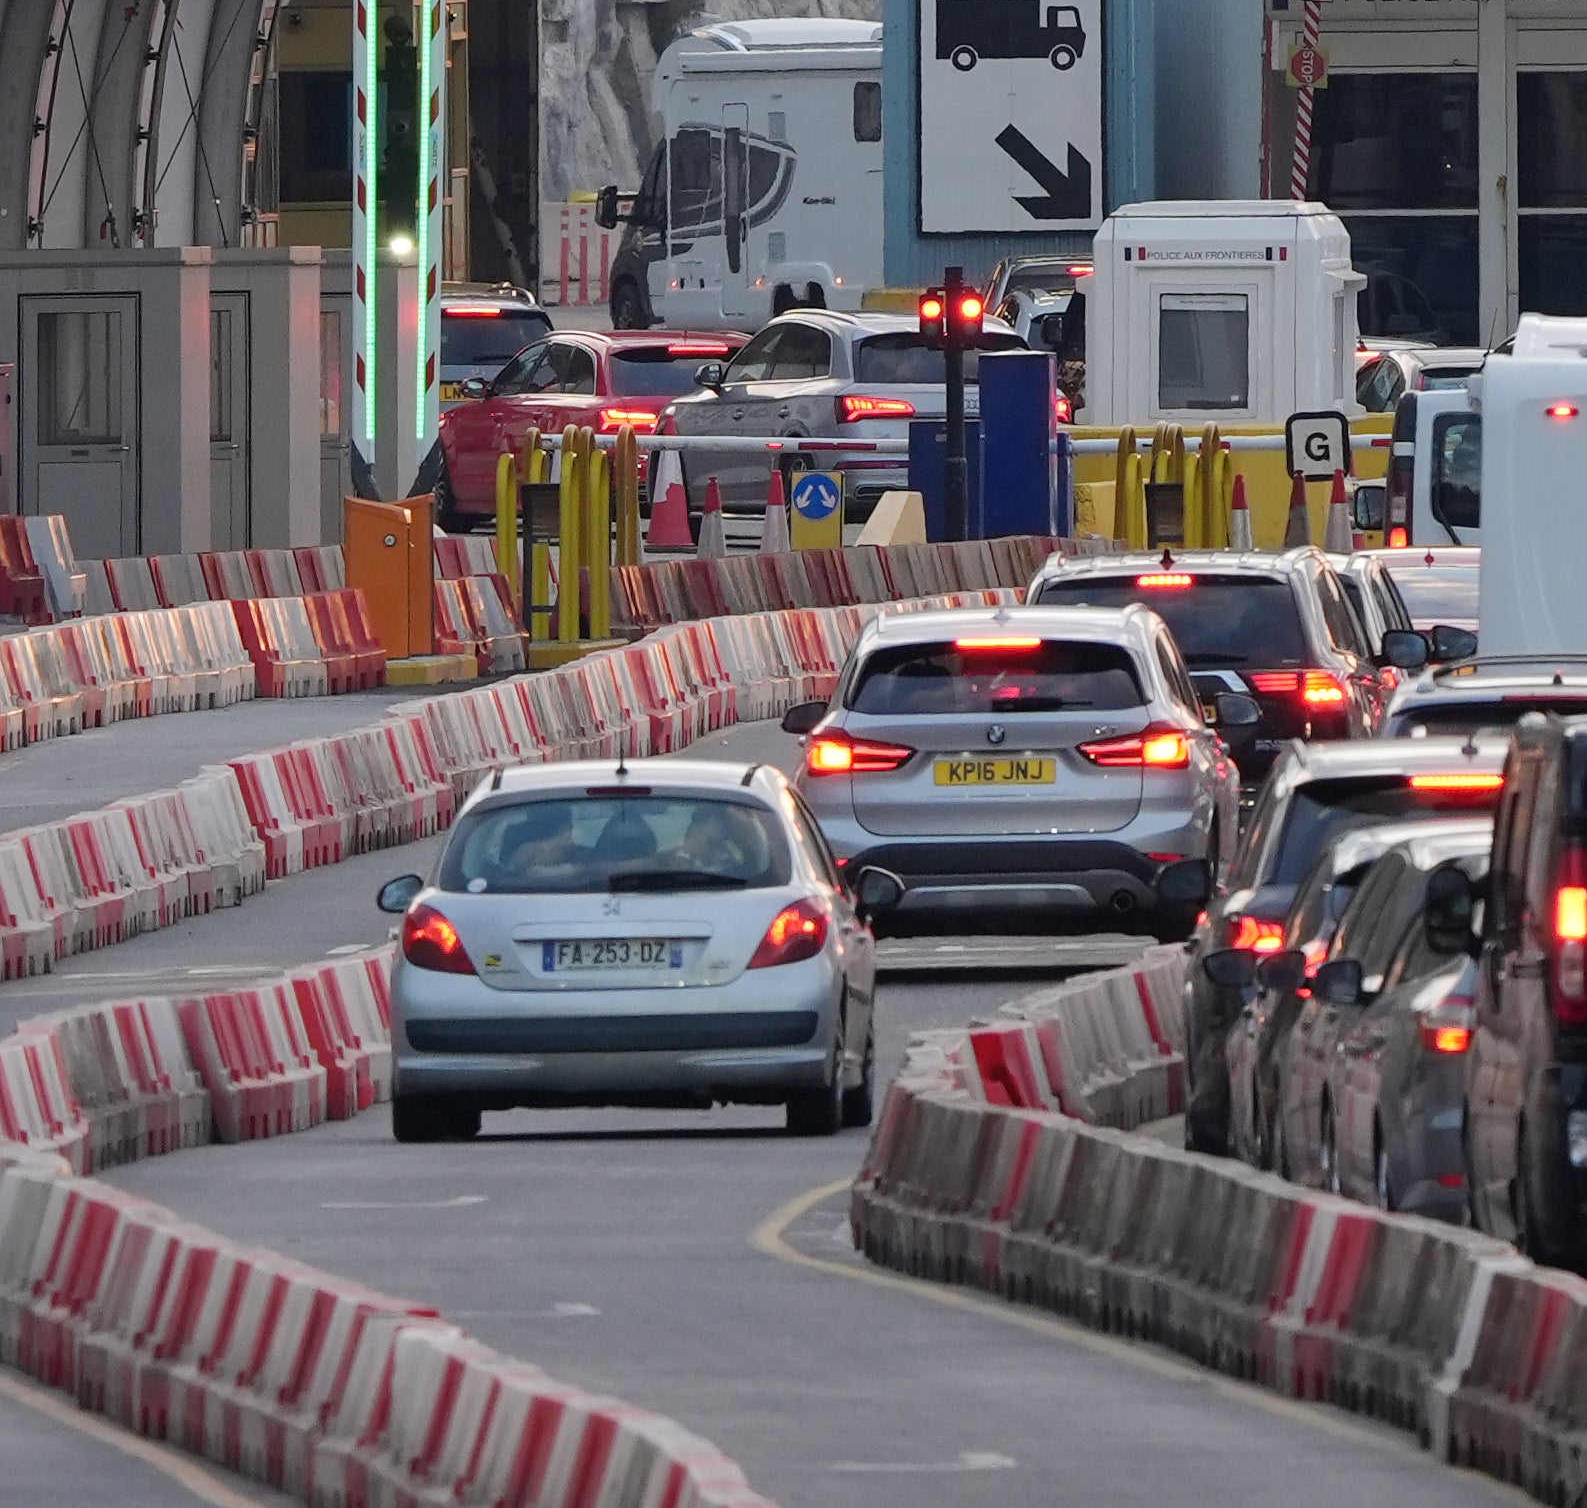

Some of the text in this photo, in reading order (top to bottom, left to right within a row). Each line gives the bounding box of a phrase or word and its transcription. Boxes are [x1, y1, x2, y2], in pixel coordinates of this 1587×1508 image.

[1301, 49, 1315, 88] STOP
[1147, 250, 1265, 260] POLICE AUX FRONTIERES
[1304, 431, 1331, 462] G
[949, 760, 1043, 782] KP16 JNJ
